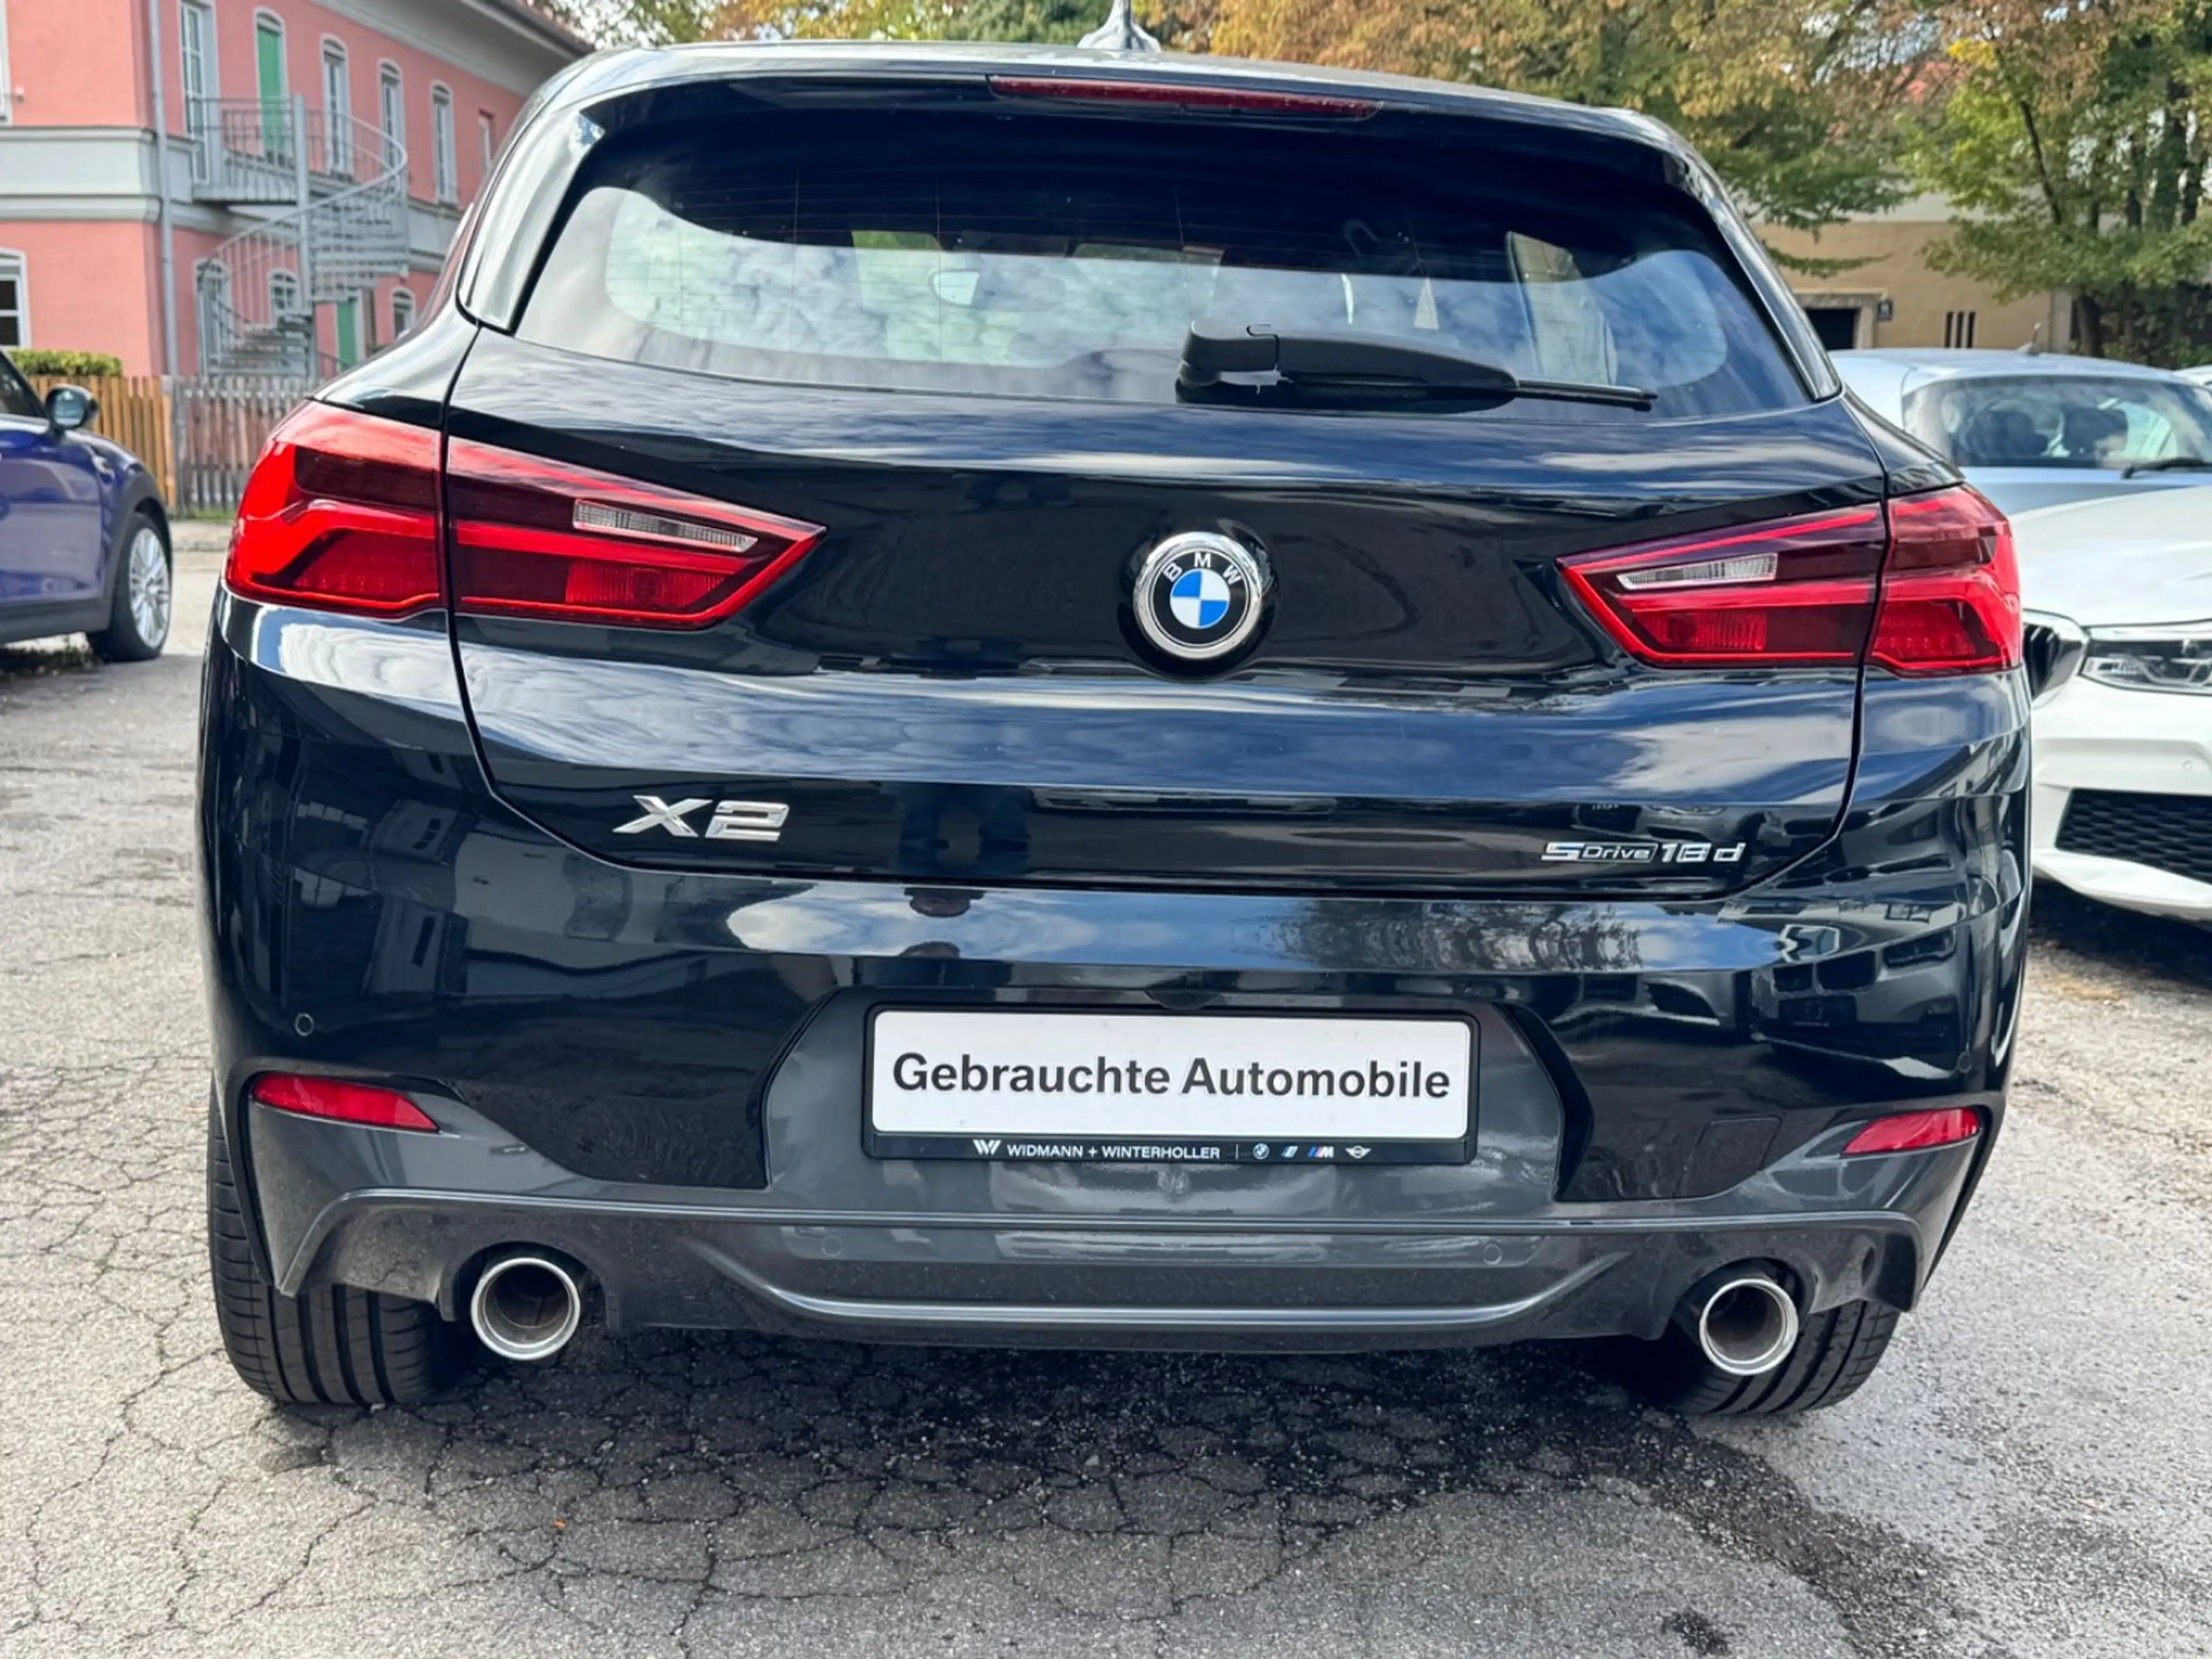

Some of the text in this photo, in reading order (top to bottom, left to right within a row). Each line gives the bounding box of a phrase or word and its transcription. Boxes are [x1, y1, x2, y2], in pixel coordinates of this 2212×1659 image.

[1163, 552, 1243, 585] BMW
[612, 794, 790, 842] X2
[892, 1052, 1451, 1098] Gebrauchte Automobile
[1006, 1145, 1084, 1157] WIDMANN
[1103, 1146, 1221, 1160] WINTERHOLLER
